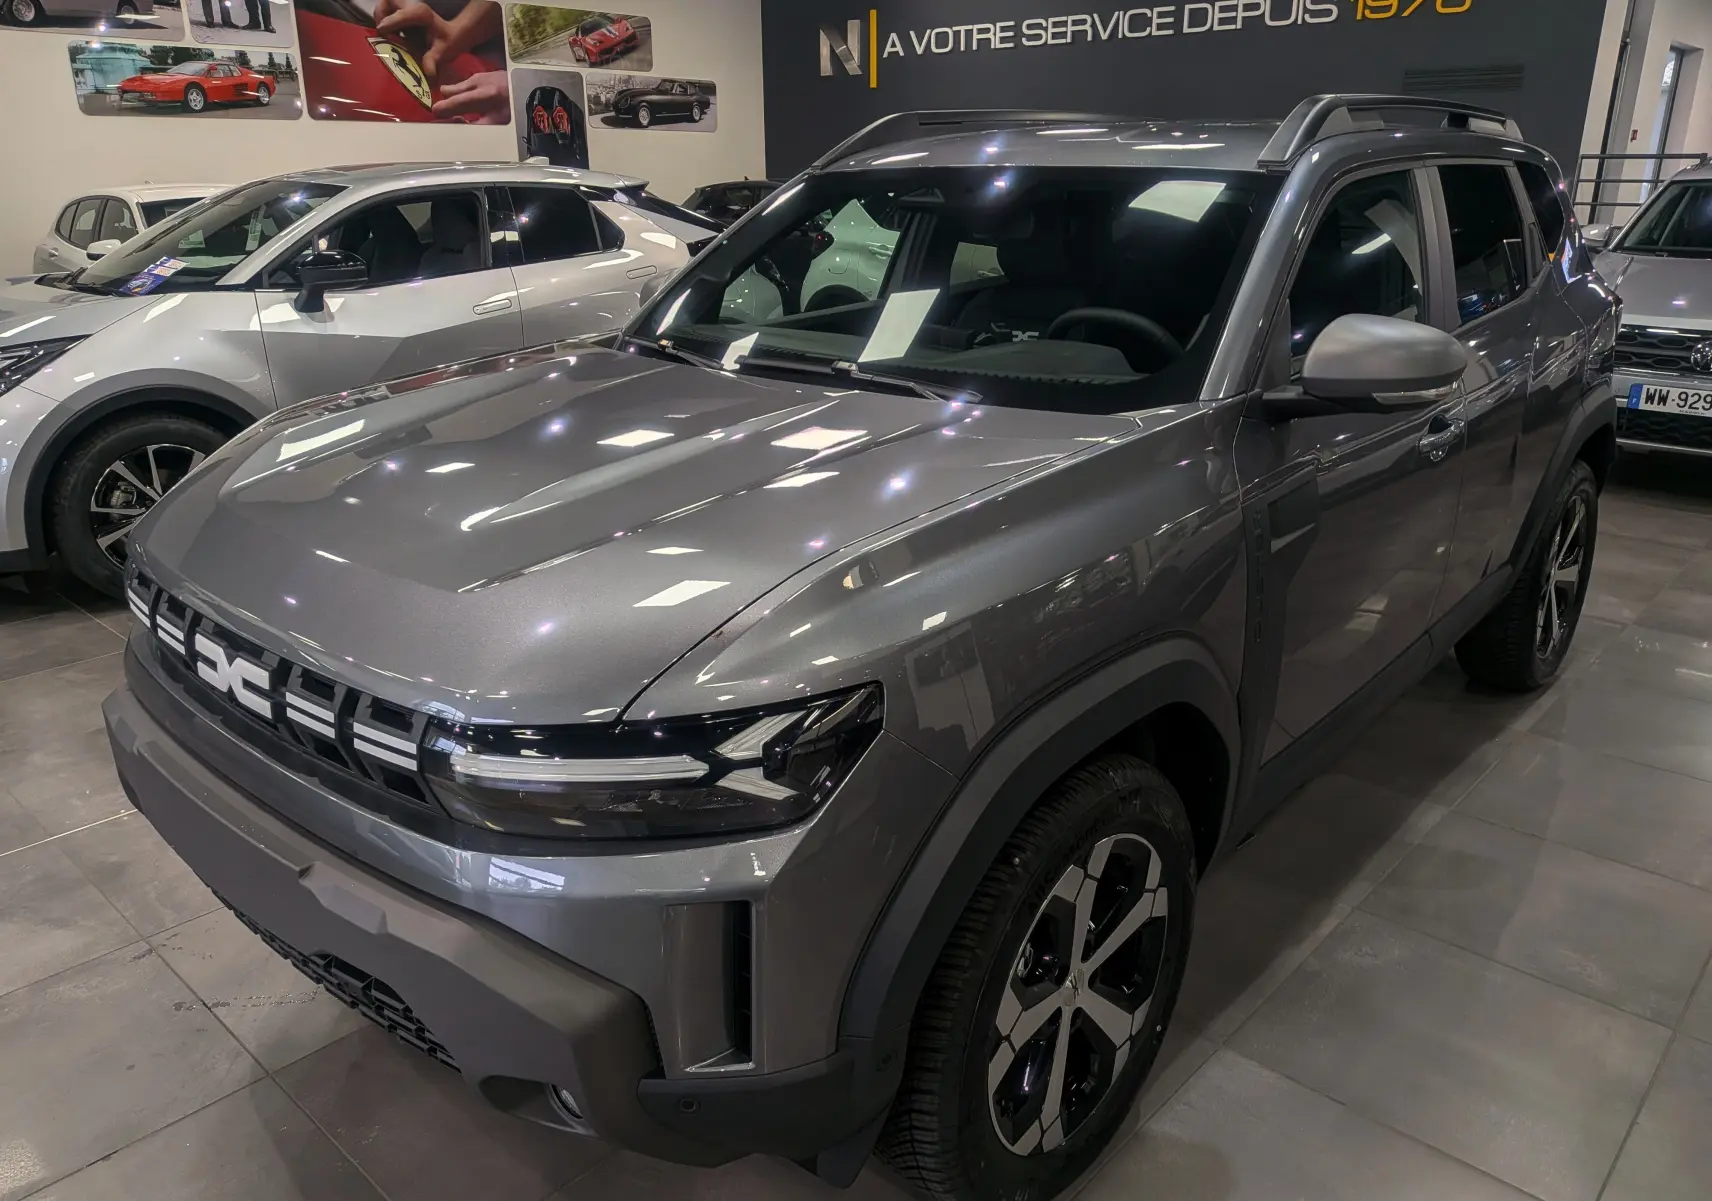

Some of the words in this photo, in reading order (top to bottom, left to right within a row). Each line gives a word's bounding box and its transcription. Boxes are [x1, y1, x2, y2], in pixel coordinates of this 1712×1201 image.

[819, 19, 863, 76] N
[882, 32, 905, 58] A
[909, 20, 1016, 55] VOTRE
[1021, 6, 1177, 47] SERVICE
[1182, 0, 1339, 34] DEPUIS
